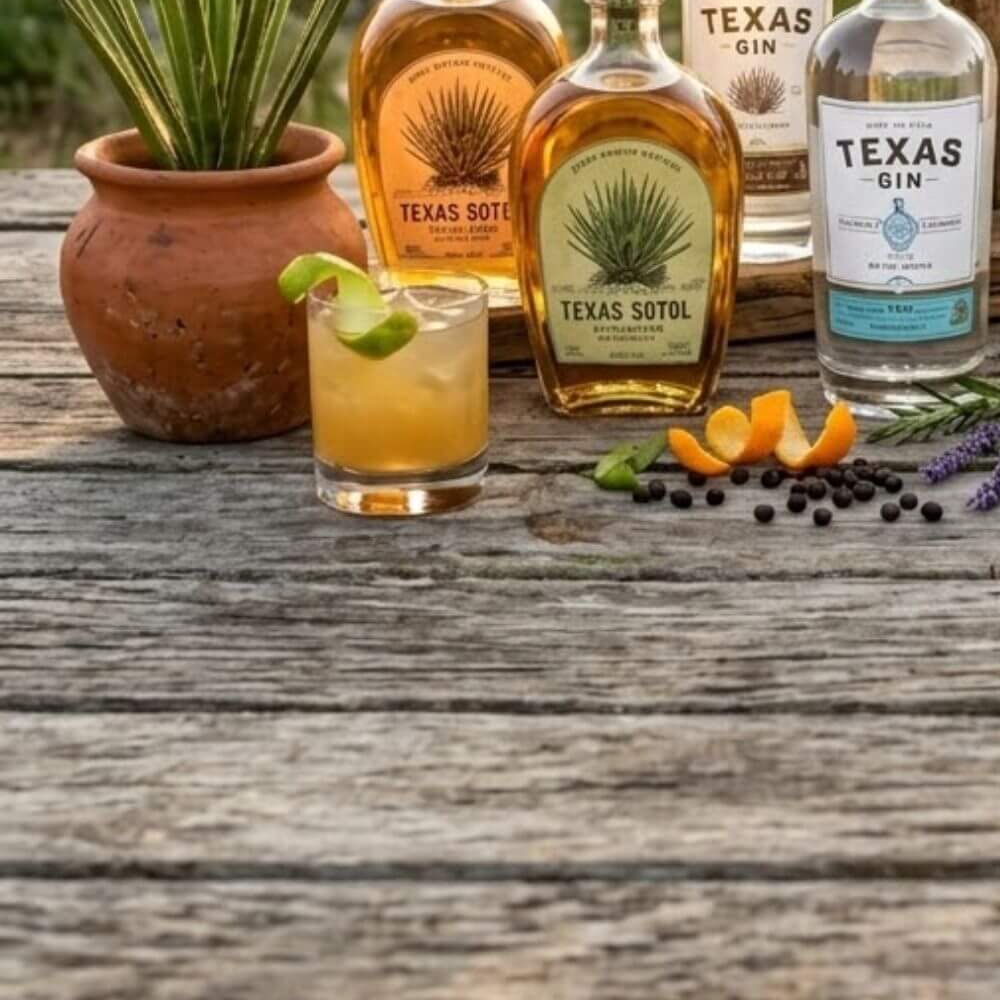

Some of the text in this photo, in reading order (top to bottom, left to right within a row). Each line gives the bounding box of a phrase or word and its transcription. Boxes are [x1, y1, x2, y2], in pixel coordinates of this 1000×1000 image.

[701, 5, 812, 35] TEXAS
[735, 39, 776, 55] GIN
[836, 137, 963, 168] TEXAS
[877, 171, 922, 189] GIN
[400, 203, 460, 222] TEXAS
[561, 299, 692, 321] TEXAS SOTOL
